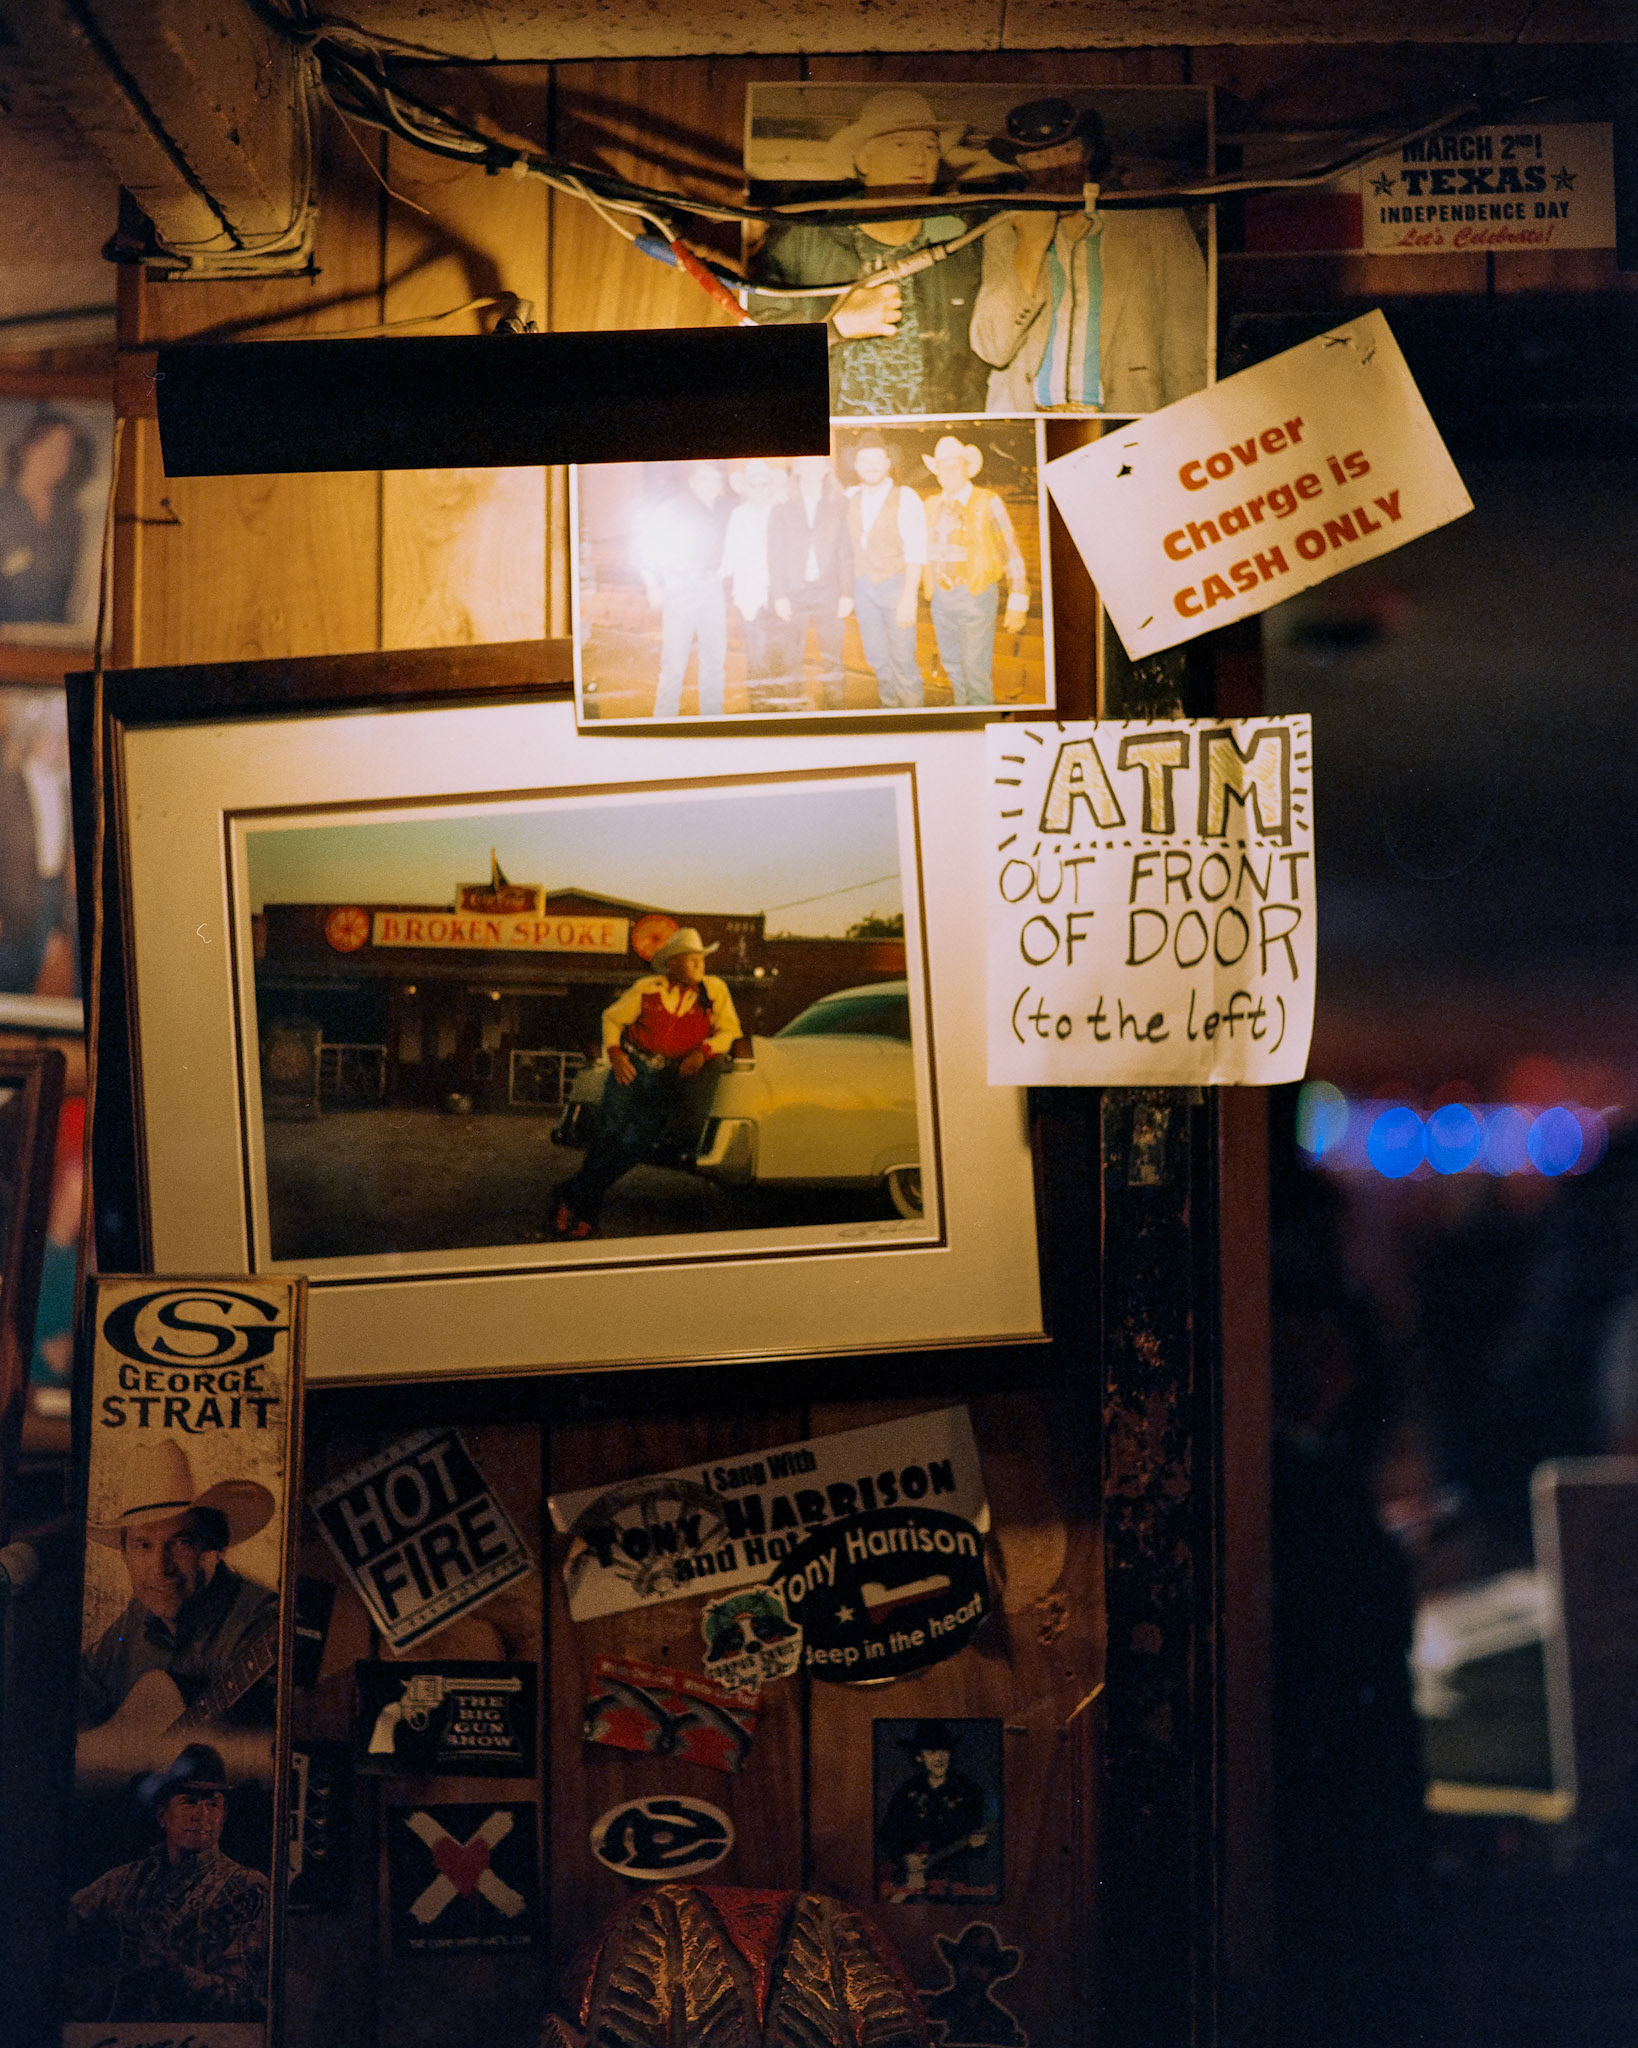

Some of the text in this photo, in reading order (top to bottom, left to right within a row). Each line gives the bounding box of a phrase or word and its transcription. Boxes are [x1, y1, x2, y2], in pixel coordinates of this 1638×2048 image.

[1402, 135, 1493, 163] MARCH
[1401, 165, 1548, 196] TEXAS
[1380, 201, 1570, 224] INDEPENDENCE DAY
[1397, 225, 1556, 248] Let's Celebrate!
[1177, 416, 1305, 492] Cover
[1162, 450, 1371, 562] Charge is
[1173, 489, 1403, 618] CASH ONLY
[1039, 726, 1292, 846] ATM
[999, 850, 1310, 904] OUT FRONT
[382, 917, 614, 947] BROKEN SPOKE
[1020, 903, 1302, 982] OF DOOR
[1012, 986, 1286, 1054] (to the left)
[118, 1364, 266, 1395] GEORGE
[100, 1395, 281, 1435] STRAIT
[714, 1462, 766, 1491] Sang
[767, 1449, 817, 1479] With
[338, 1440, 459, 1558] HOT
[585, 1459, 956, 1568] TONY HARRISON
[368, 1499, 507, 1620] FIRE
[674, 1544, 738, 1581] and
[845, 1518, 979, 1566] Harrison
[863, 1639, 886, 1660] in
[888, 1628, 926, 1655] the
[929, 1591, 983, 1639] heart
[457, 1695, 506, 1708] THE
[457, 1708, 501, 1721] BIG
[445, 1733, 514, 1748] SHOW
[452, 1721, 504, 1734] GUN
